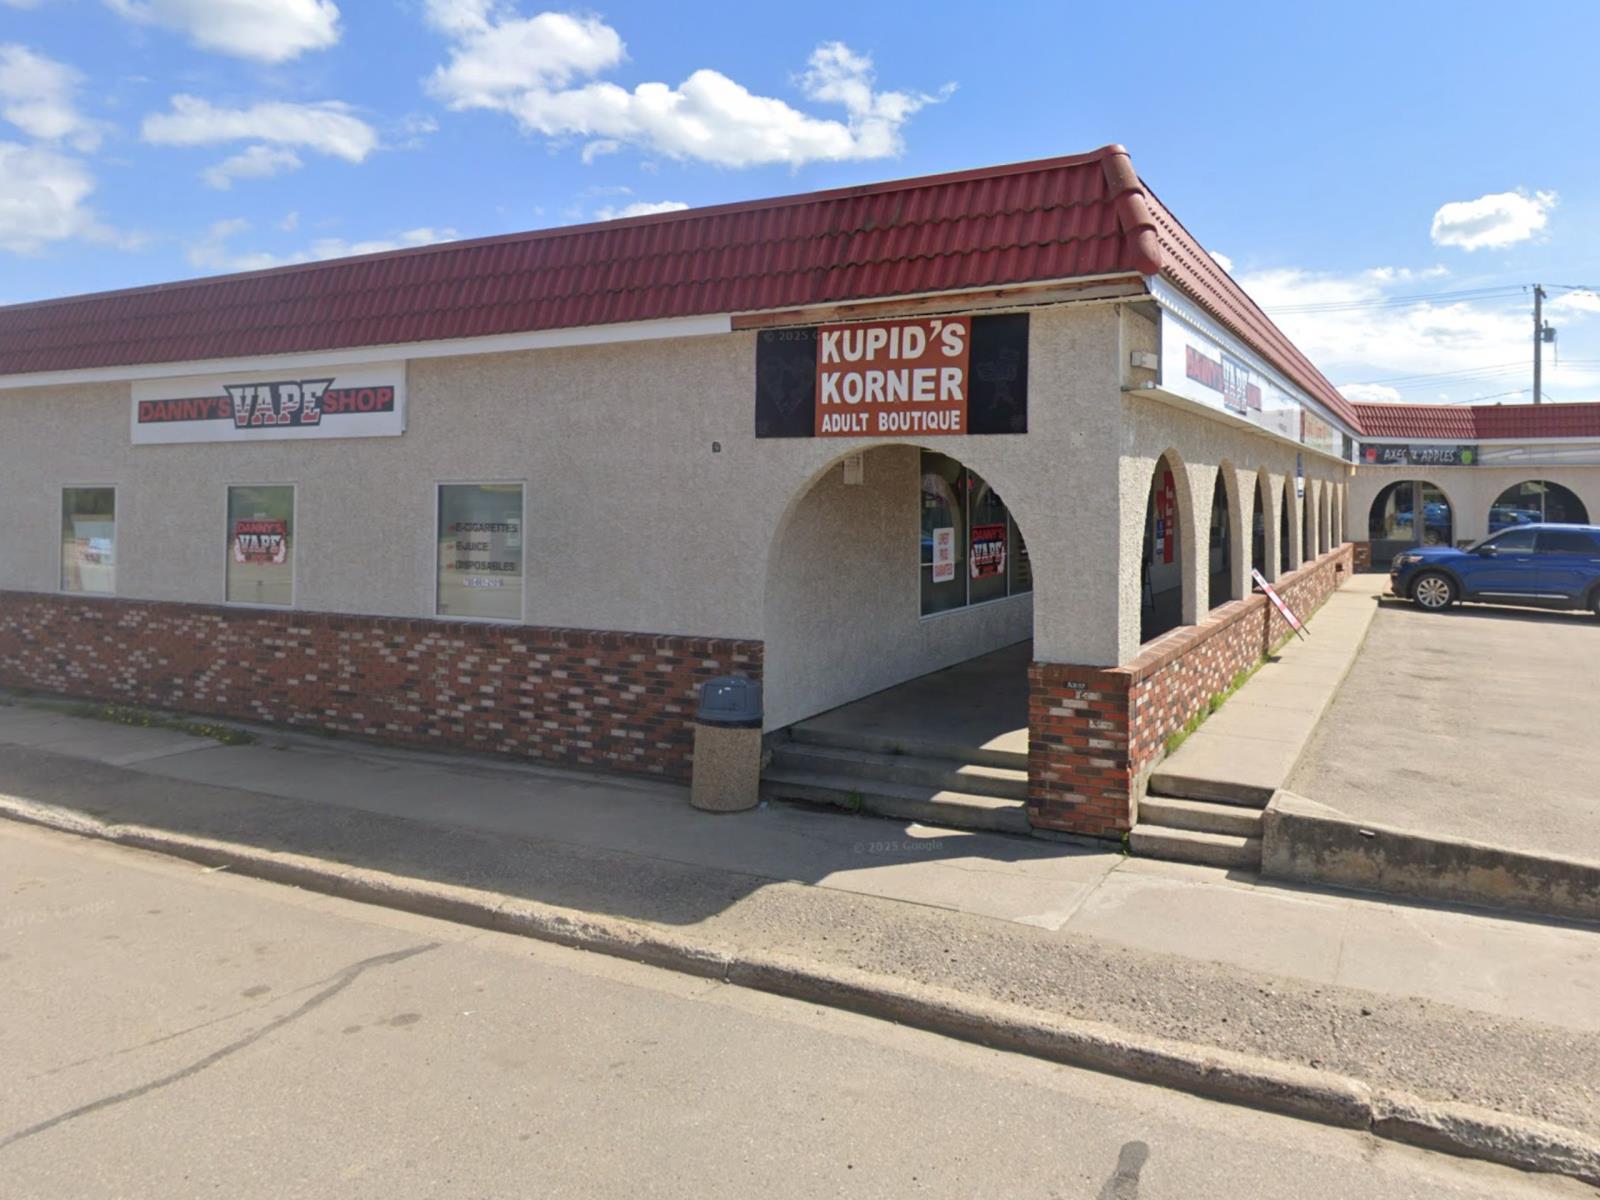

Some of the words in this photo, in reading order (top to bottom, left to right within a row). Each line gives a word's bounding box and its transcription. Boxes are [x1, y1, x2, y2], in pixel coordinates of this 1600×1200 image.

[821, 319, 966, 364] KUPID'S
[821, 367, 963, 404] KORNER
[139, 396, 231, 422] DANNY'S
[229, 381, 328, 427] VAPE
[322, 387, 394, 413] SHOP
[822, 412, 869, 432] ADULT
[878, 410, 961, 431] BOUTIQUE
[1421, 449, 1455, 463] APPLES
[239, 534, 282, 553] VAPE
[455, 560, 516, 571] DISPOSABLES
